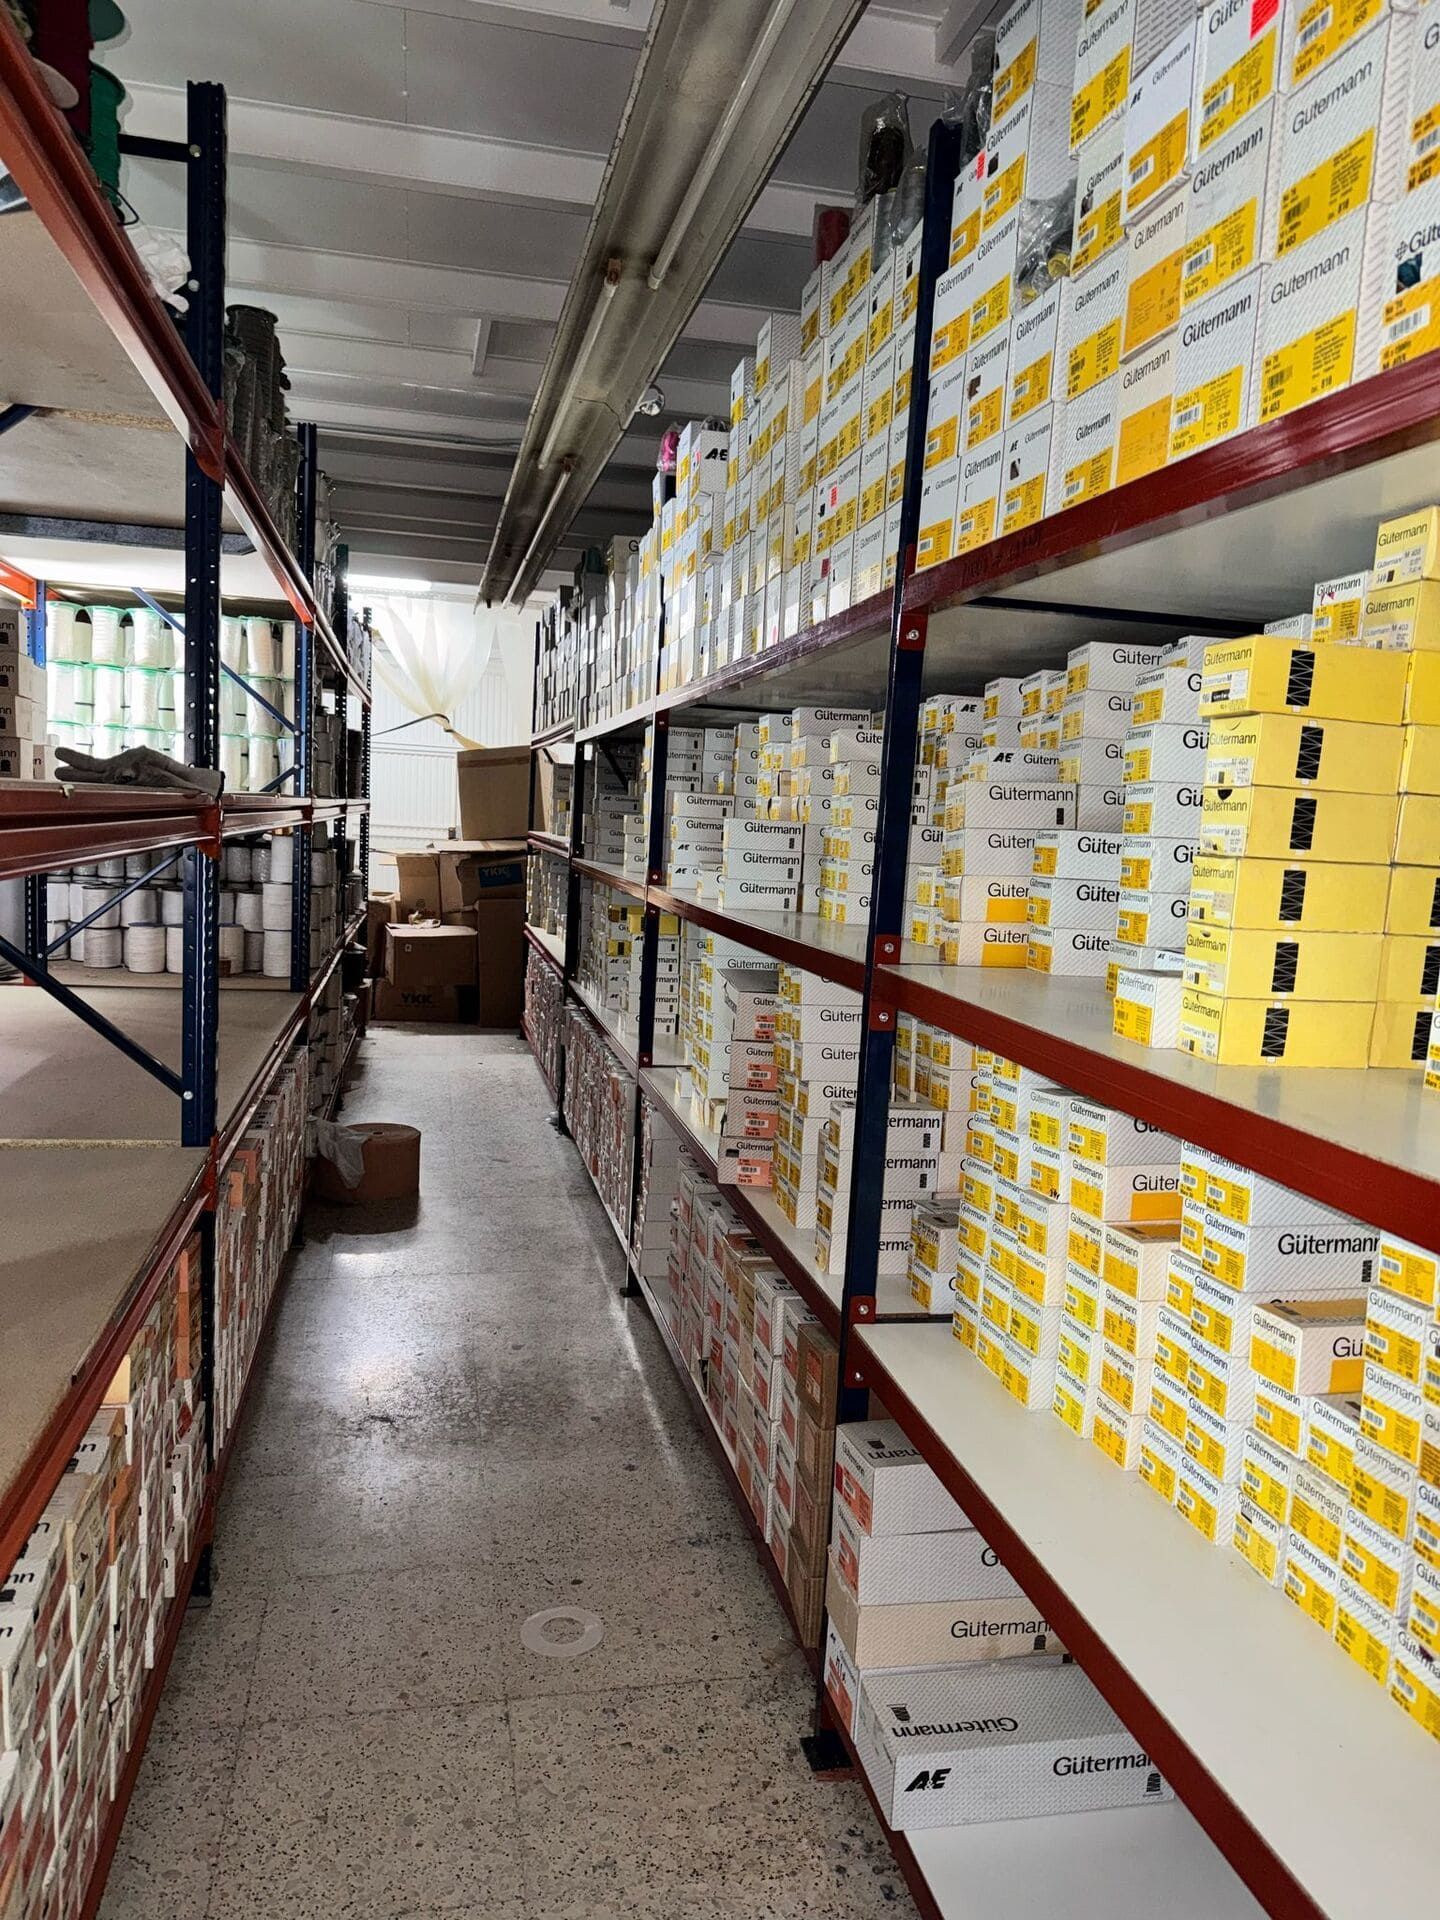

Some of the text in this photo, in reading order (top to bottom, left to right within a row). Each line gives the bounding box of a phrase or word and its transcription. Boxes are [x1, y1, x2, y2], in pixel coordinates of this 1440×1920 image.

[1182, 294, 1251, 347] Gütermann
[814, 710, 870, 722] Gütermann
[993, 753, 1015, 763] AE
[686, 795, 733, 807] Gütermann
[989, 785, 1074, 802] Gütermann
[744, 822, 801, 835] Gütermann
[1077, 836, 1121, 855] Güter
[743, 852, 800, 866] Gütermann
[739, 882, 797, 896] Gütermann
[1205, 1213, 1246, 1241] Gütermann
[1194, 1275, 1234, 1307] Gütermann
[1191, 1337, 1229, 1371] Gütermann
[1189, 1397, 1227, 1433] Gütermann
[1245, 1433, 1289, 1474] Gütermann
[1181, 1456, 1219, 1497] Gütermann
[1289, 1532, 1336, 1581] Gütermann
[892, 1717, 1019, 1738] Gütermann
